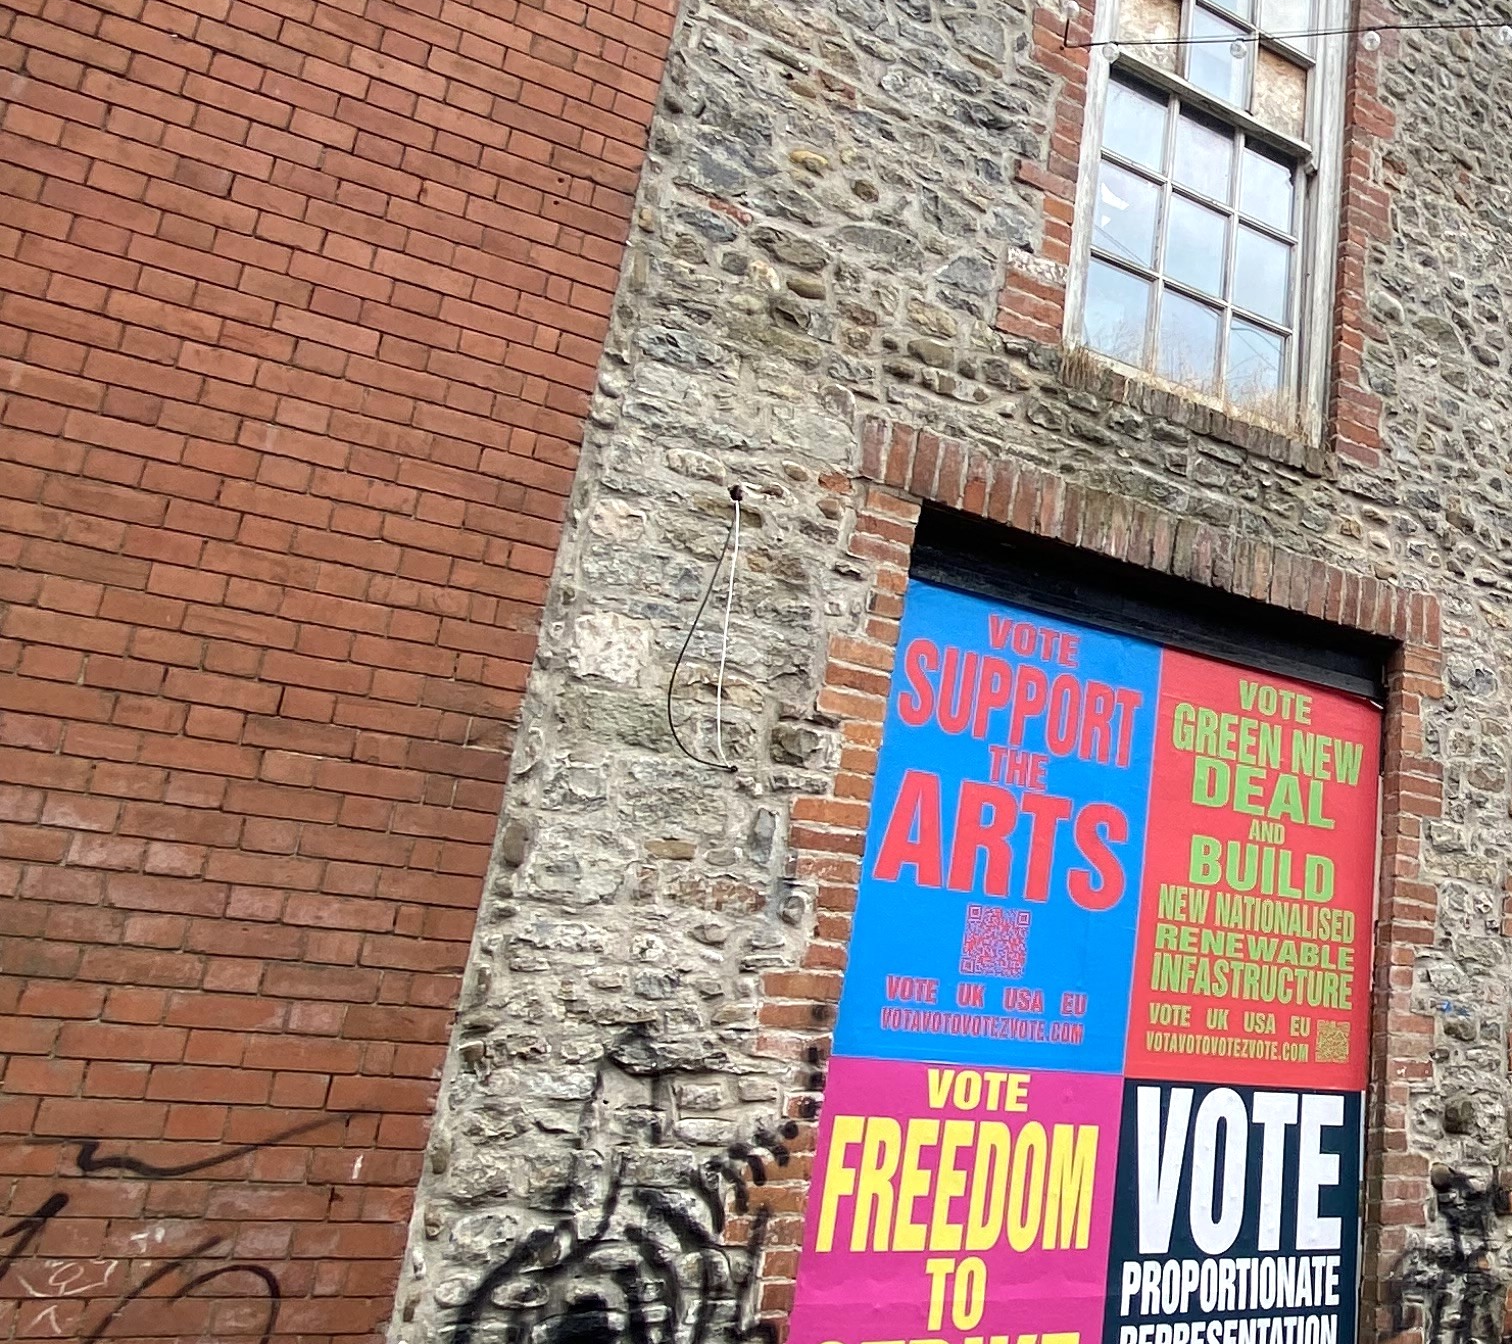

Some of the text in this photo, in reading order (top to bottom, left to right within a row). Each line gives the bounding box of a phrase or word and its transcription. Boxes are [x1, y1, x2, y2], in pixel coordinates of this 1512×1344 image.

[988, 613, 1081, 668] VOTE
[897, 638, 1143, 768] SUPPORT
[1239, 679, 1312, 725] VOTE
[989, 745, 1048, 791] THE
[1173, 702, 1363, 786] GREEN NEW
[1191, 756, 1336, 829] DEAL
[872, 768, 1128, 911] ARTS
[1249, 819, 1286, 845] AND
[1189, 834, 1334, 903] BUILD
[1158, 884, 1355, 944] NEW NATIONALISED
[1155, 923, 1355, 971] RENEWABLE
[886, 975, 1088, 1015] VOTE UK USA EU
[1151, 952, 1353, 1010] INFASTRUCTURE
[1146, 1031, 1309, 1062] VOTAVOTOVOTEZVOTE.COM
[1150, 1003, 1311, 1037] VOTE UK USA EU
[927, 1069, 1031, 1113] VOTE
[815, 1115, 1100, 1253] FREEDOM
[1136, 1086, 1345, 1255] VOTE
[926, 1256, 986, 1331] TO
[1120, 1255, 1341, 1317] PROPORTIONATE
